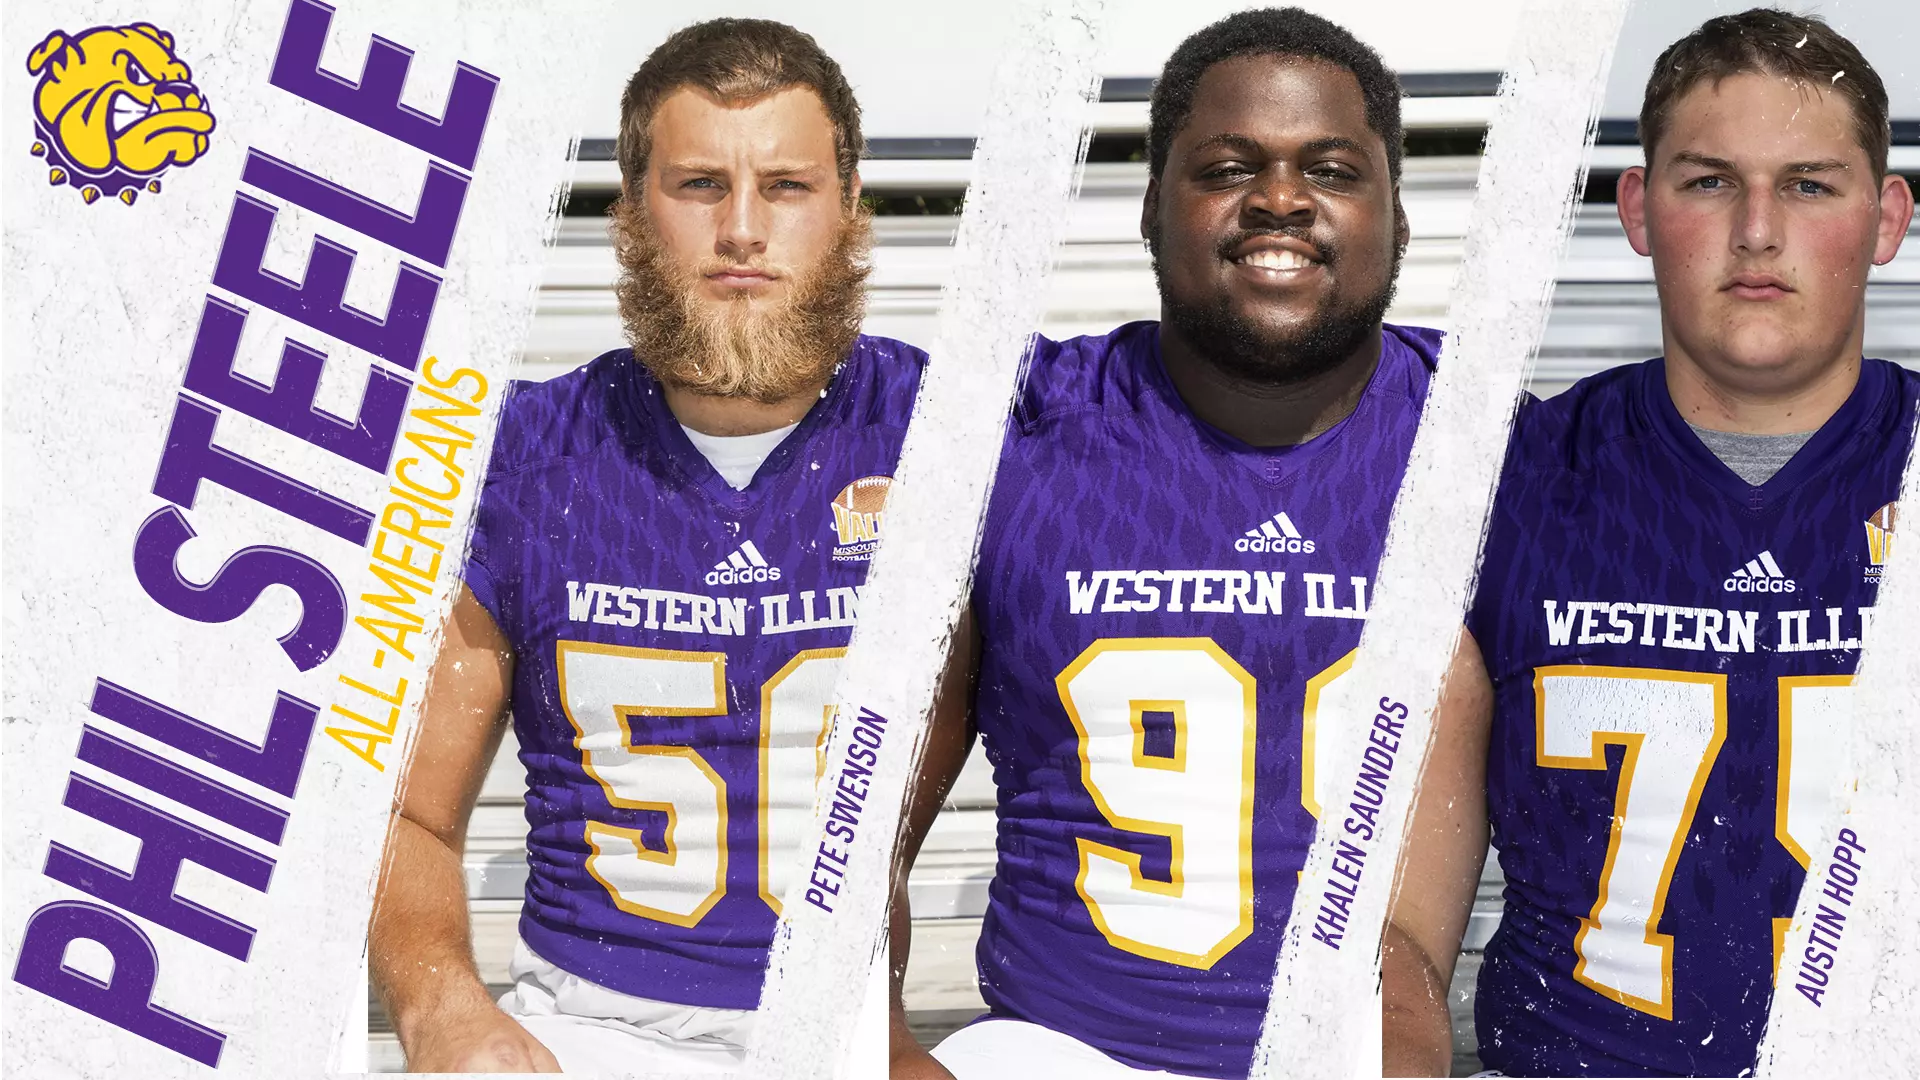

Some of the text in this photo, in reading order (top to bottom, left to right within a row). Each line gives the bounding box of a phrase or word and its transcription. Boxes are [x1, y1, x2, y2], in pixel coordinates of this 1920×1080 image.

[1234, 535, 1316, 553] adidas
[705, 566, 781, 585] adidas
[1724, 575, 1797, 593] adidas
[566, 580, 747, 636] WESTERN
[1065, 570, 1286, 615] WESTERN
[1543, 600, 1759, 653] WESTERN
